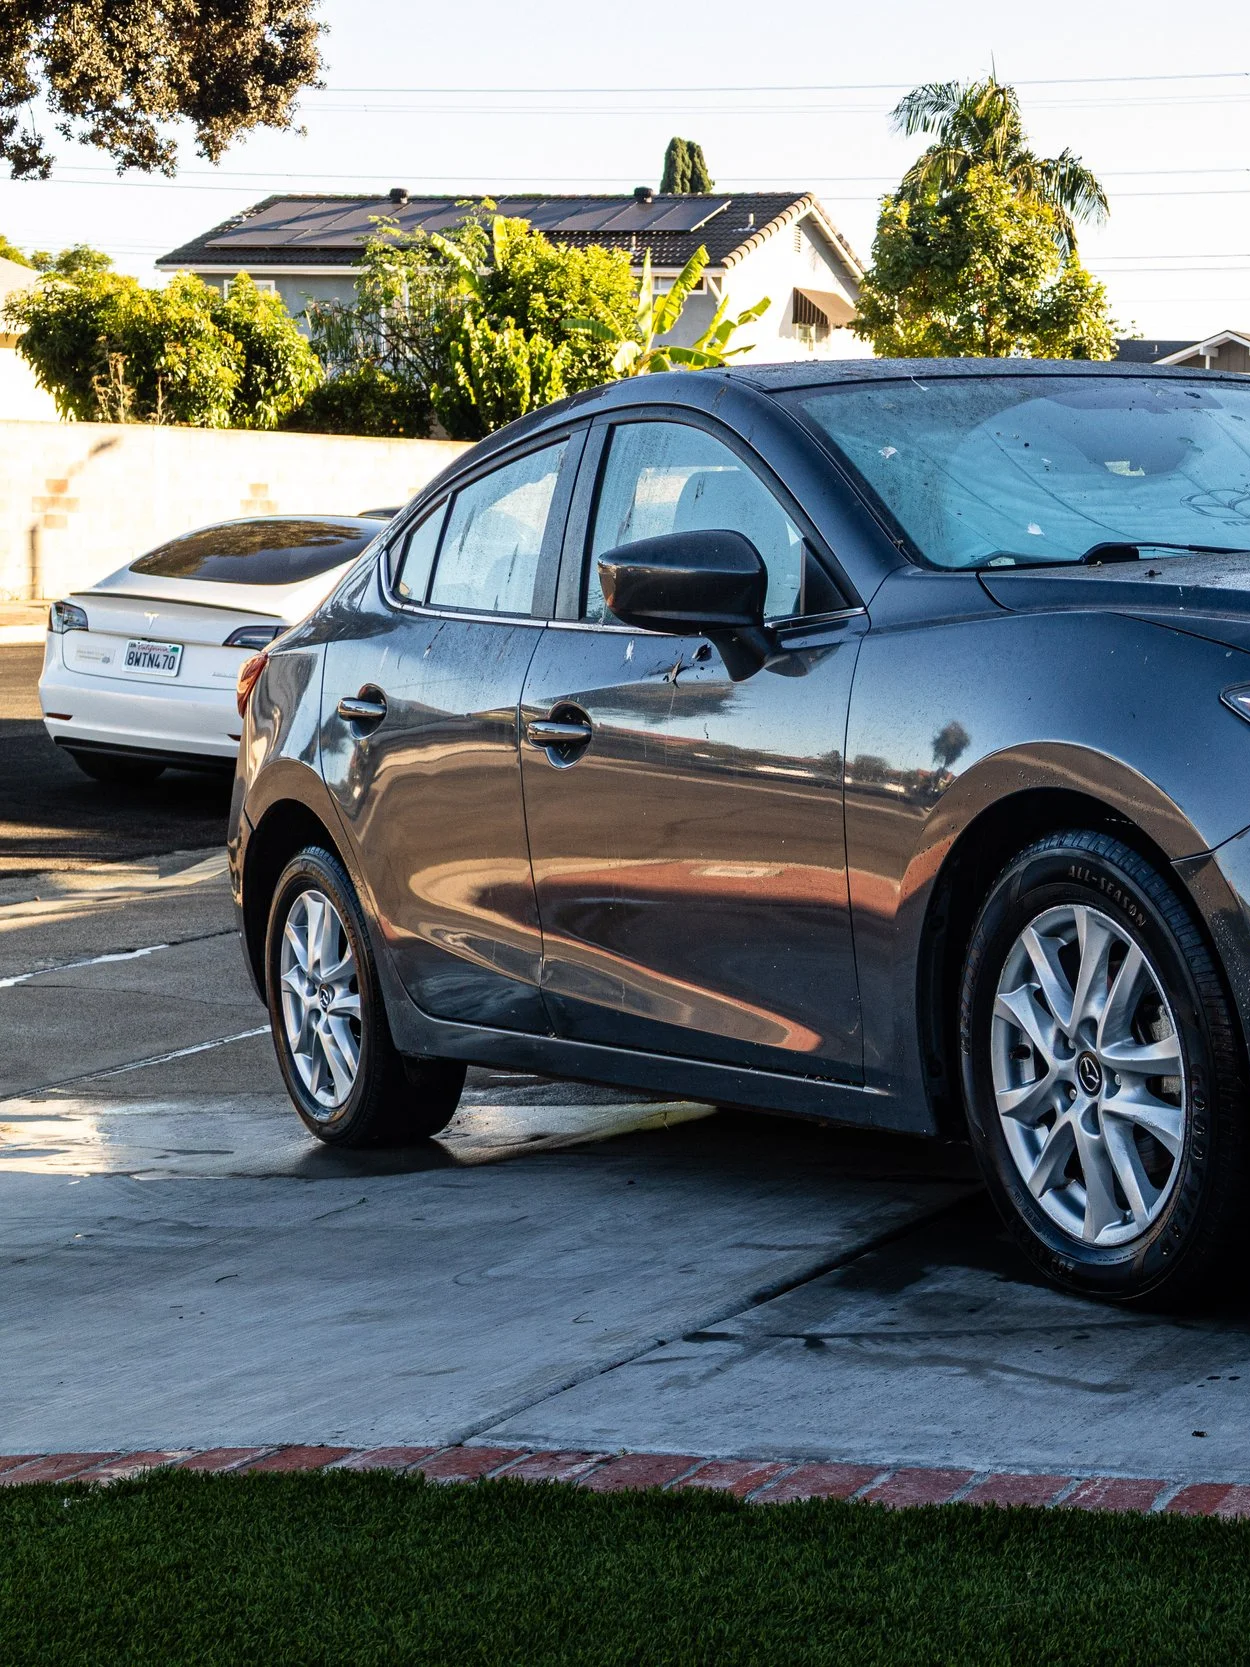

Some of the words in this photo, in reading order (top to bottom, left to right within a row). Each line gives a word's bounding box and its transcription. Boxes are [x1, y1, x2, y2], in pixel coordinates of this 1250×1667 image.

[138, 644, 169, 652] California
[127, 651, 176, 670] 8WTN470
[1067, 864, 1147, 928] ALL-SEASON
